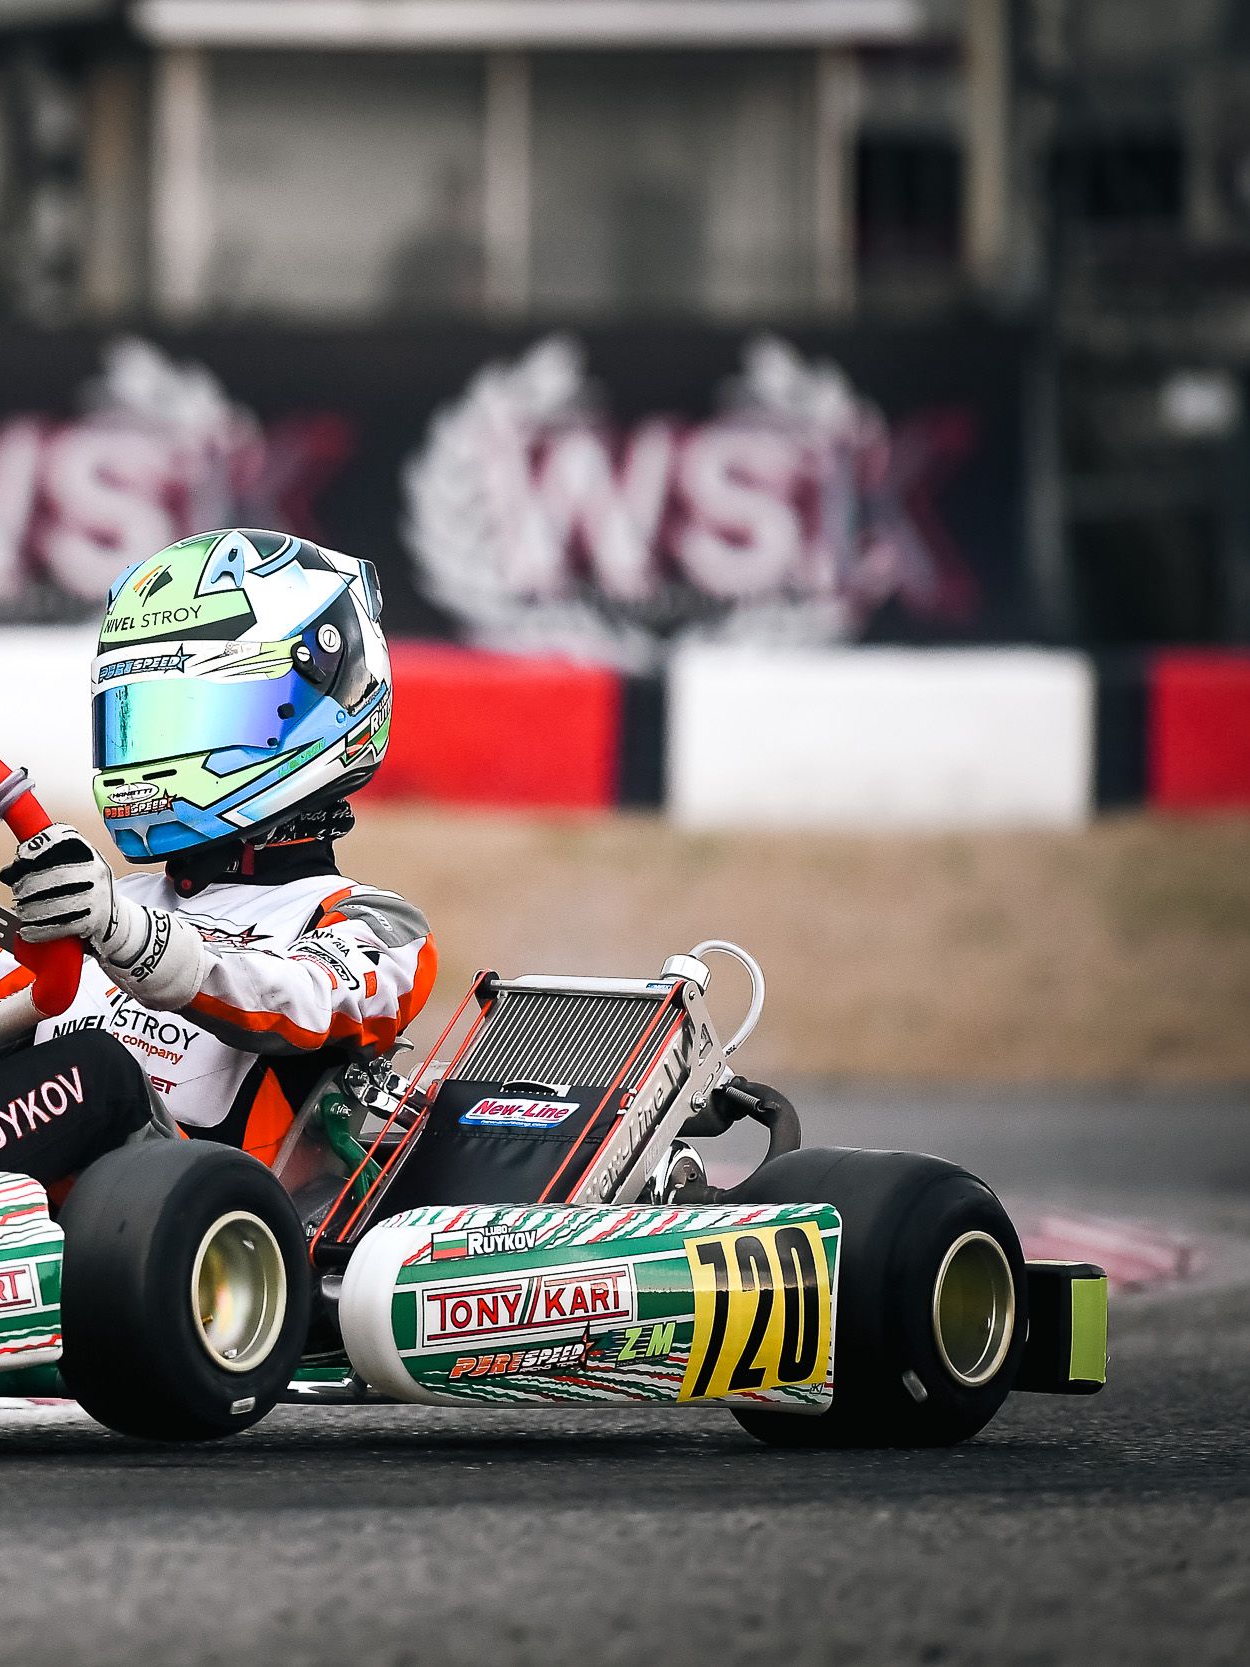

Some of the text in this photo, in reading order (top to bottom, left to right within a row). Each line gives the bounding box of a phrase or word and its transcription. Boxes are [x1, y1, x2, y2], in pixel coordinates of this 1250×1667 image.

[492, 415, 975, 612] WSK
[104, 605, 202, 633] NIVEL STROY
[53, 1009, 200, 1050] NIVEL STROY
[122, 1034, 183, 1065] company
[472, 1100, 570, 1119] New-Line
[467, 1230, 537, 1256] RUYKOV
[485, 1225, 508, 1236] LUBO
[690, 1226, 819, 1398] 720
